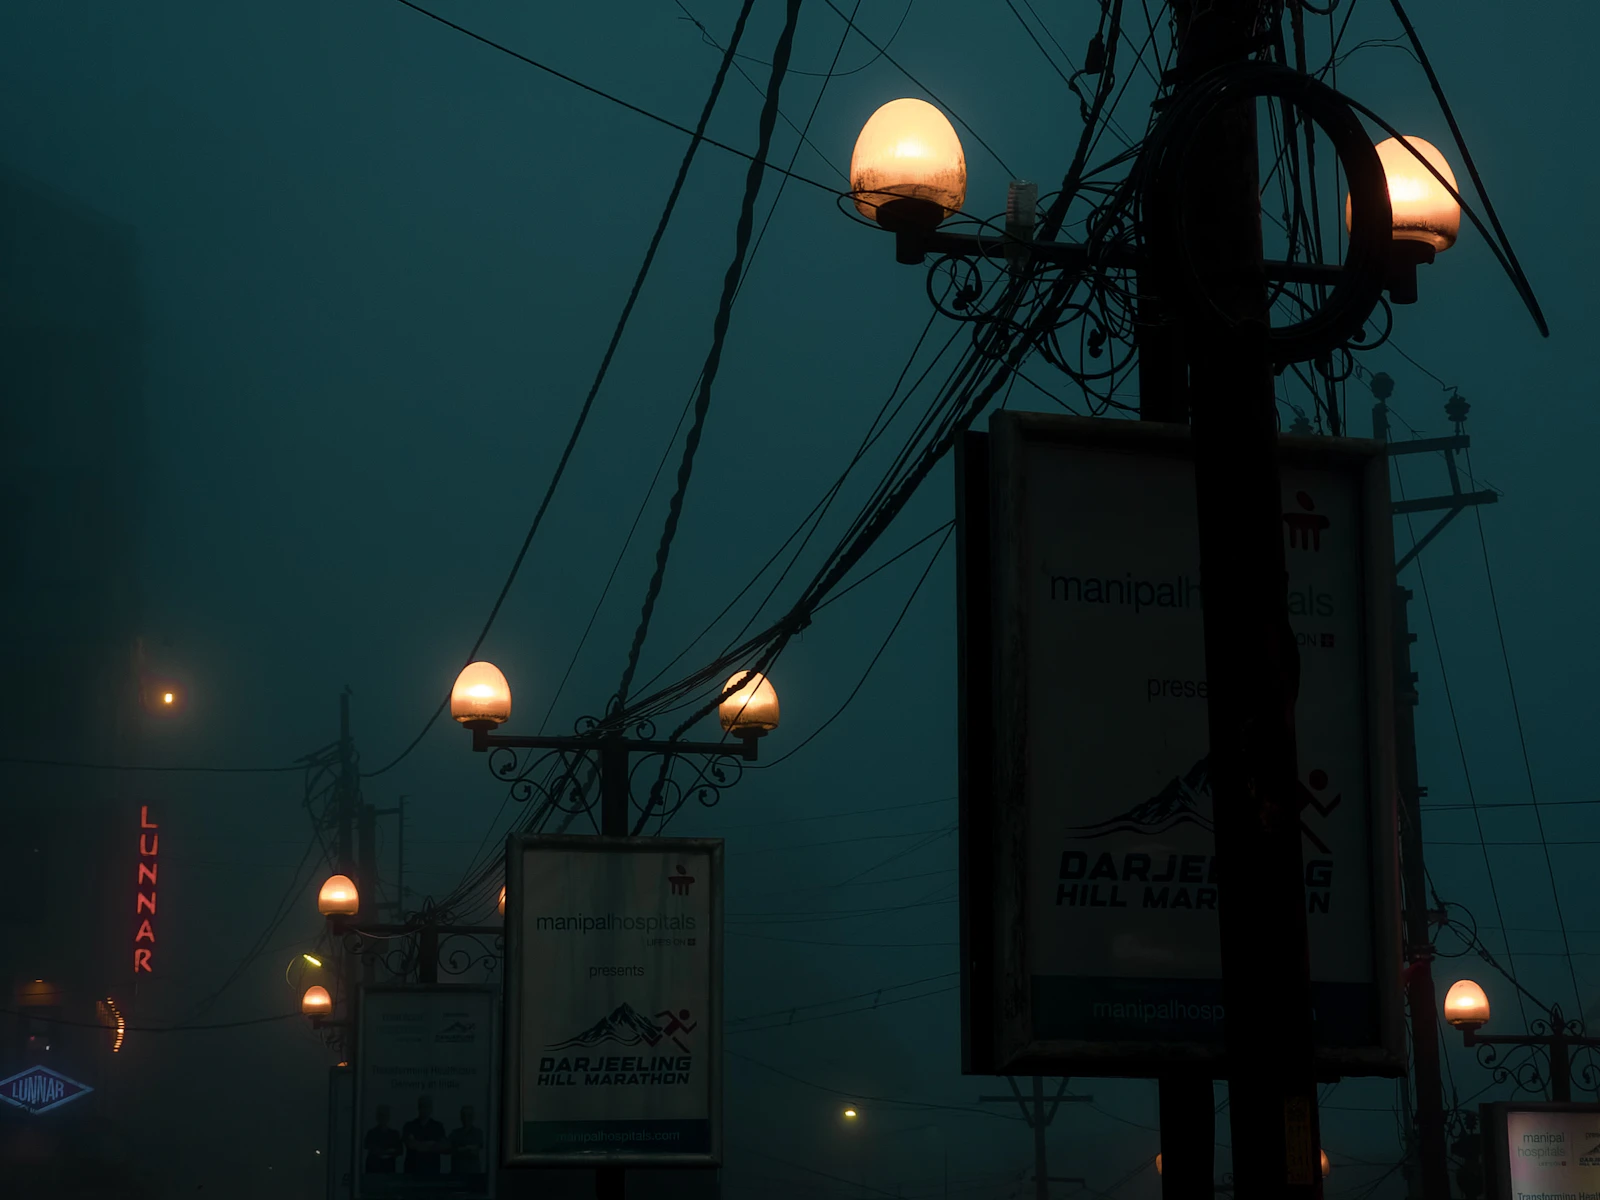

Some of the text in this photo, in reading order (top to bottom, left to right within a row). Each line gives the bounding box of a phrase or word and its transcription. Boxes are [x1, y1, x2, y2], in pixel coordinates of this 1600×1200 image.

[1050, 572, 1334, 617] manipalhals
[1147, 677, 1209, 703] prese
[1059, 850, 1333, 888] DARJEG
[134, 805, 159, 973] LUNNAR
[1056, 883, 1331, 914] HILL MARN
[536, 912, 696, 934] manipalhospitals
[674, 938, 686, 947] ON
[588, 964, 645, 979] presents
[539, 1056, 691, 1073] DARJEELING
[537, 1072, 689, 1086] HILL MARATHON
[12, 1075, 65, 1104] LUNNAR
[556, 1128, 680, 1145] manipalhospitals.com
[1523, 1132, 1565, 1145] manipal
[1517, 1146, 1566, 1159] hospitals
